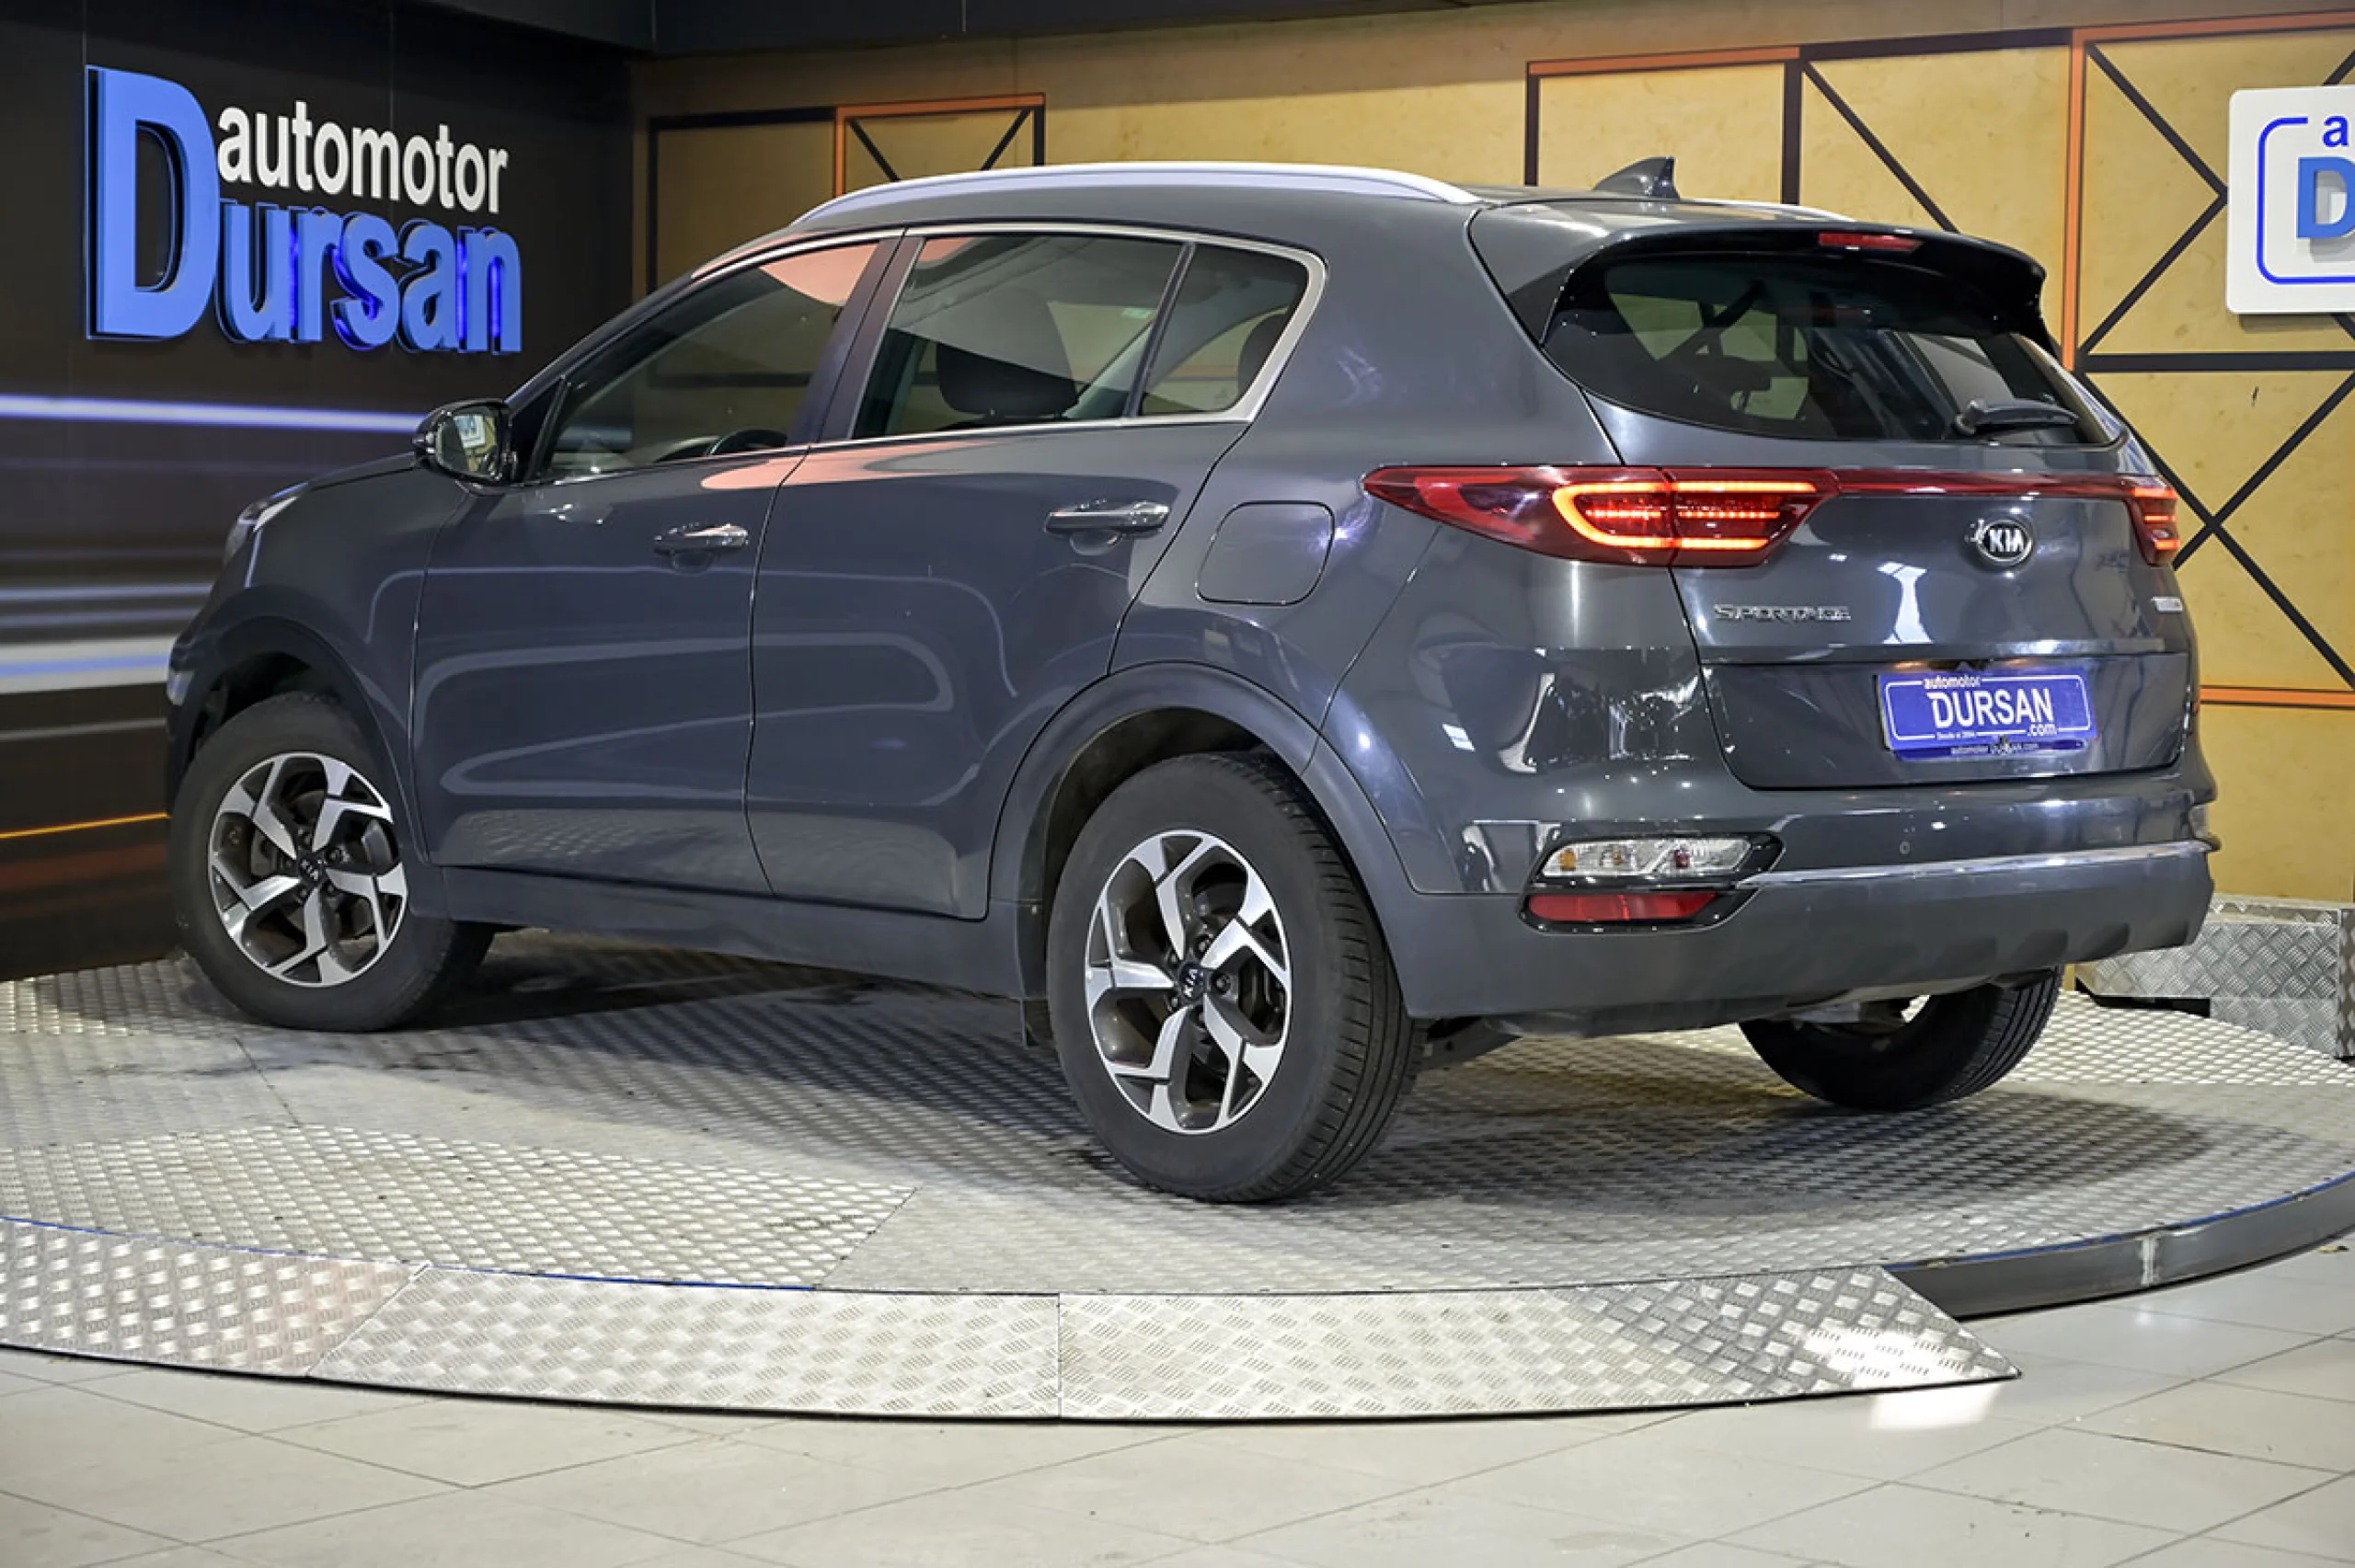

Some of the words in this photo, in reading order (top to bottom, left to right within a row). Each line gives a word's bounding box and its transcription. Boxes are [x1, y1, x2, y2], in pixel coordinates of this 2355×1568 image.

[217, 100, 510, 214] automotor
[86, 63, 523, 356] Dursan
[1989, 528, 2024, 553] KIA
[1713, 603, 1852, 622] SPORTAGE
[1924, 674, 1981, 689] automotor
[1926, 688, 2054, 727] DURSAN
[2027, 723, 2057, 737] .com
